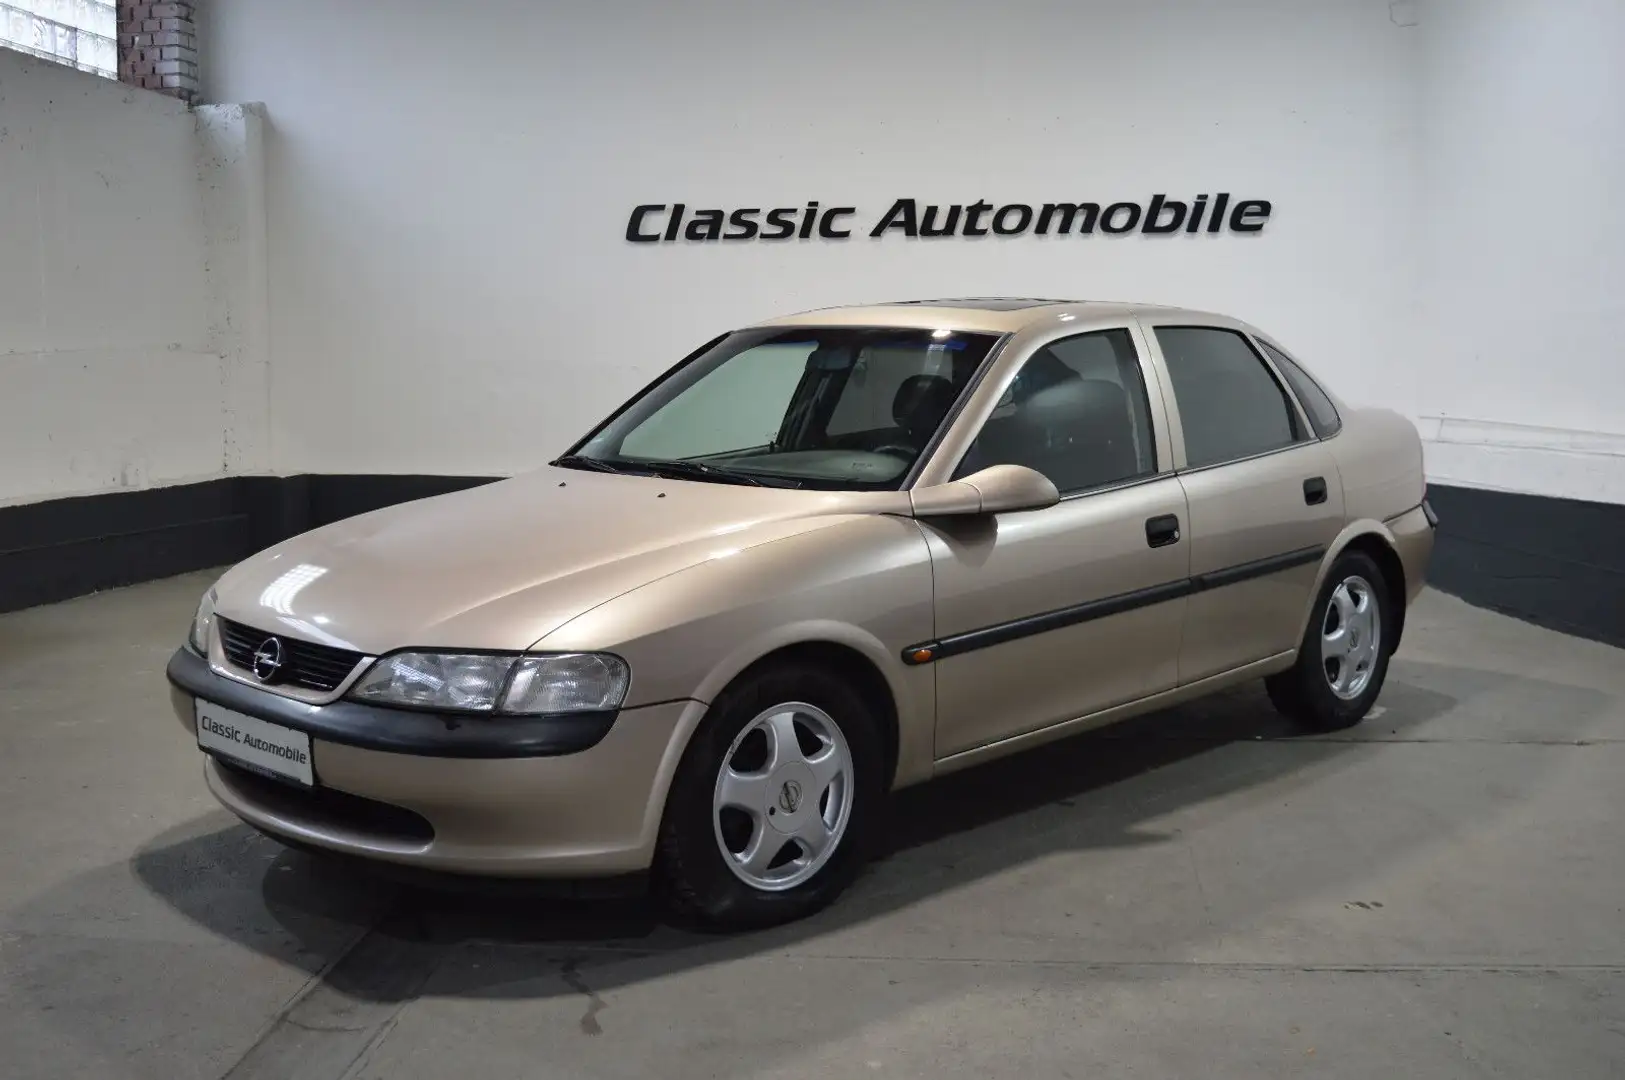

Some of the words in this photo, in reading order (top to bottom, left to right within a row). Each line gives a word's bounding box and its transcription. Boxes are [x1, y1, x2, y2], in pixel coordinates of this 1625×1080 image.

[626, 202, 856, 243] Classic
[869, 193, 1272, 238] Automobile
[202, 715, 241, 742] Classic
[243, 733, 307, 765] Automobile
